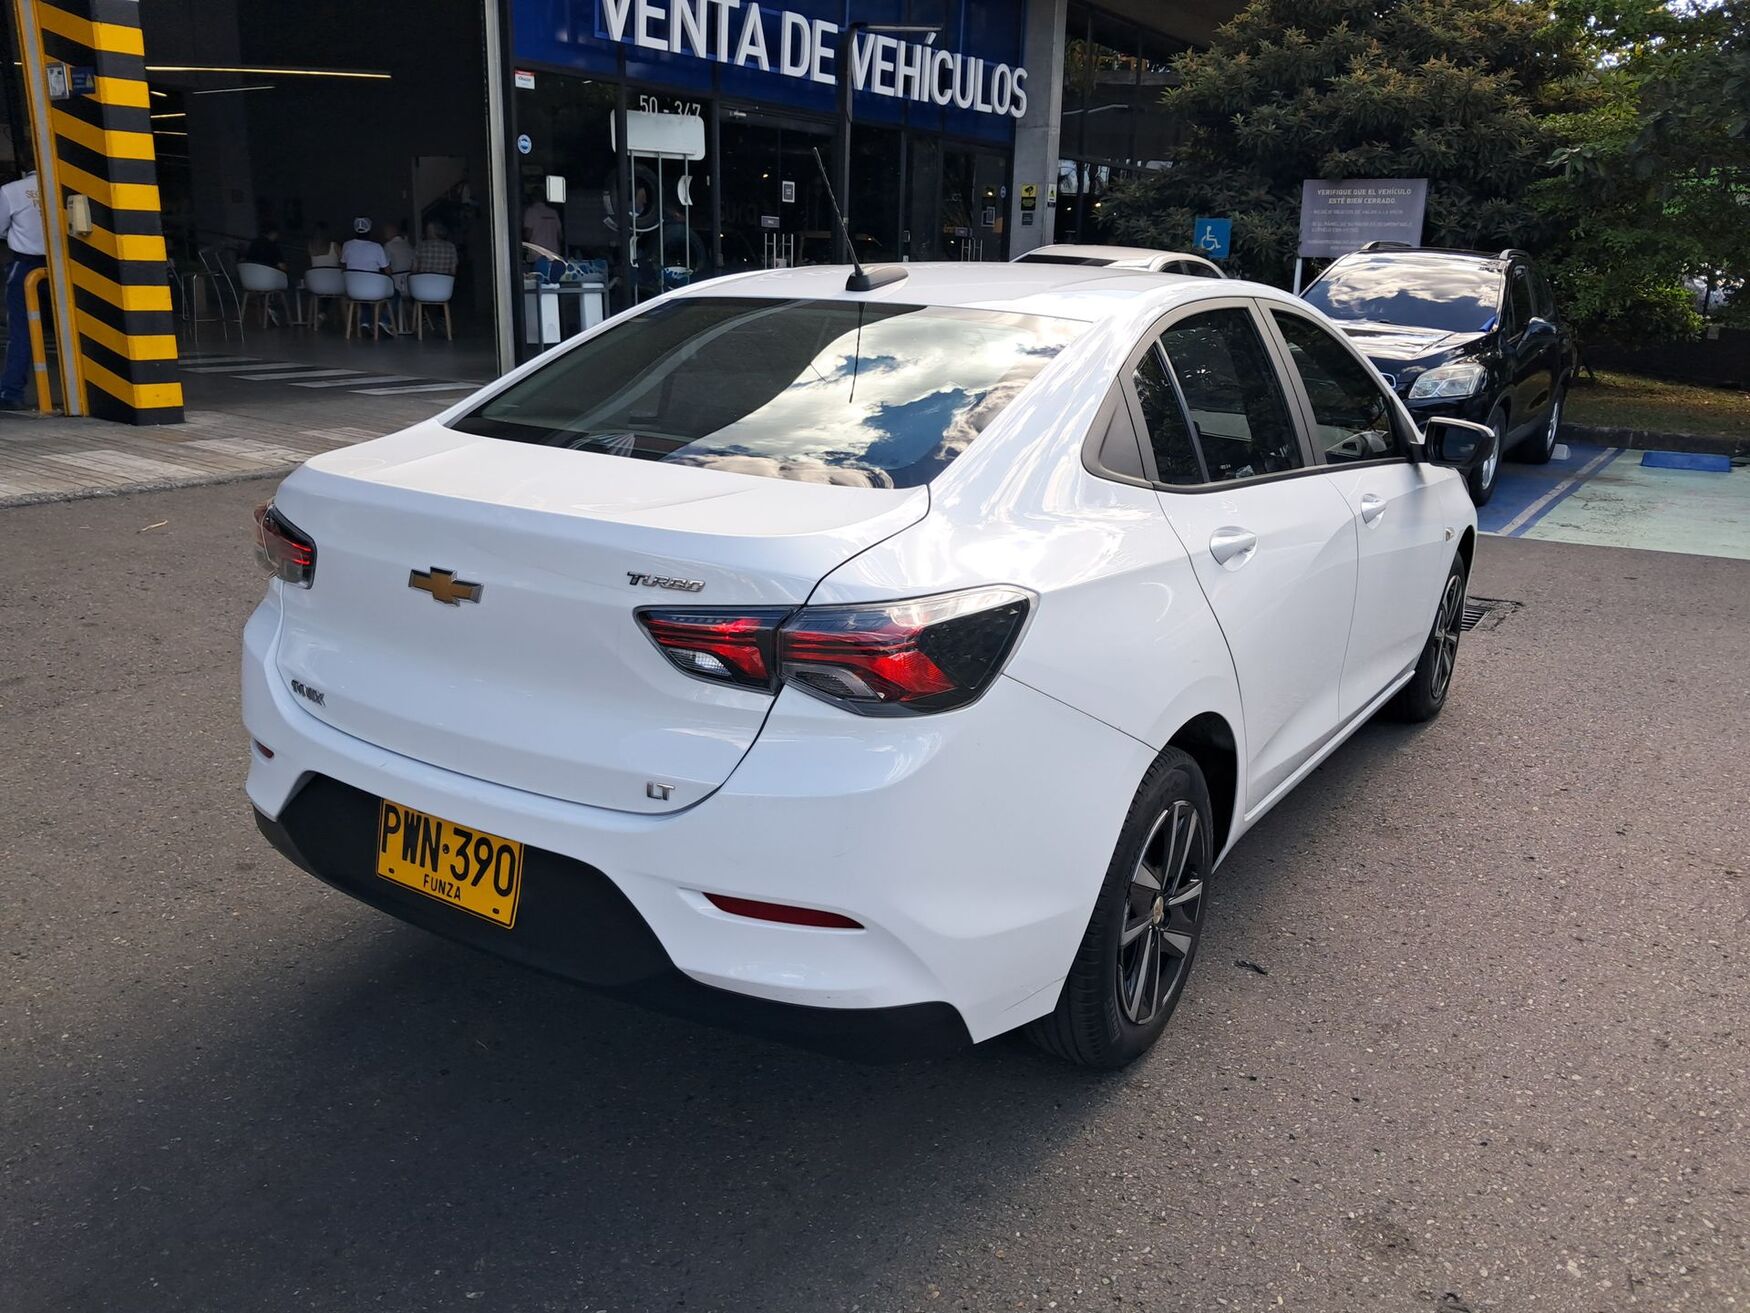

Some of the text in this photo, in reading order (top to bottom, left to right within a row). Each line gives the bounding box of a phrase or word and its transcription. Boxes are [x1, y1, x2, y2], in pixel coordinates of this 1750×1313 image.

[602, 0, 1028, 118] VENTA DE VEHÍCULOS
[640, 95, 658, 115] 50
[1368, 188, 1376, 196] EL
[1378, 187, 1412, 195] VEHÍCULO
[627, 571, 706, 593] TURBO
[646, 781, 675, 801] LT
[423, 874, 461, 902] FUNZA
